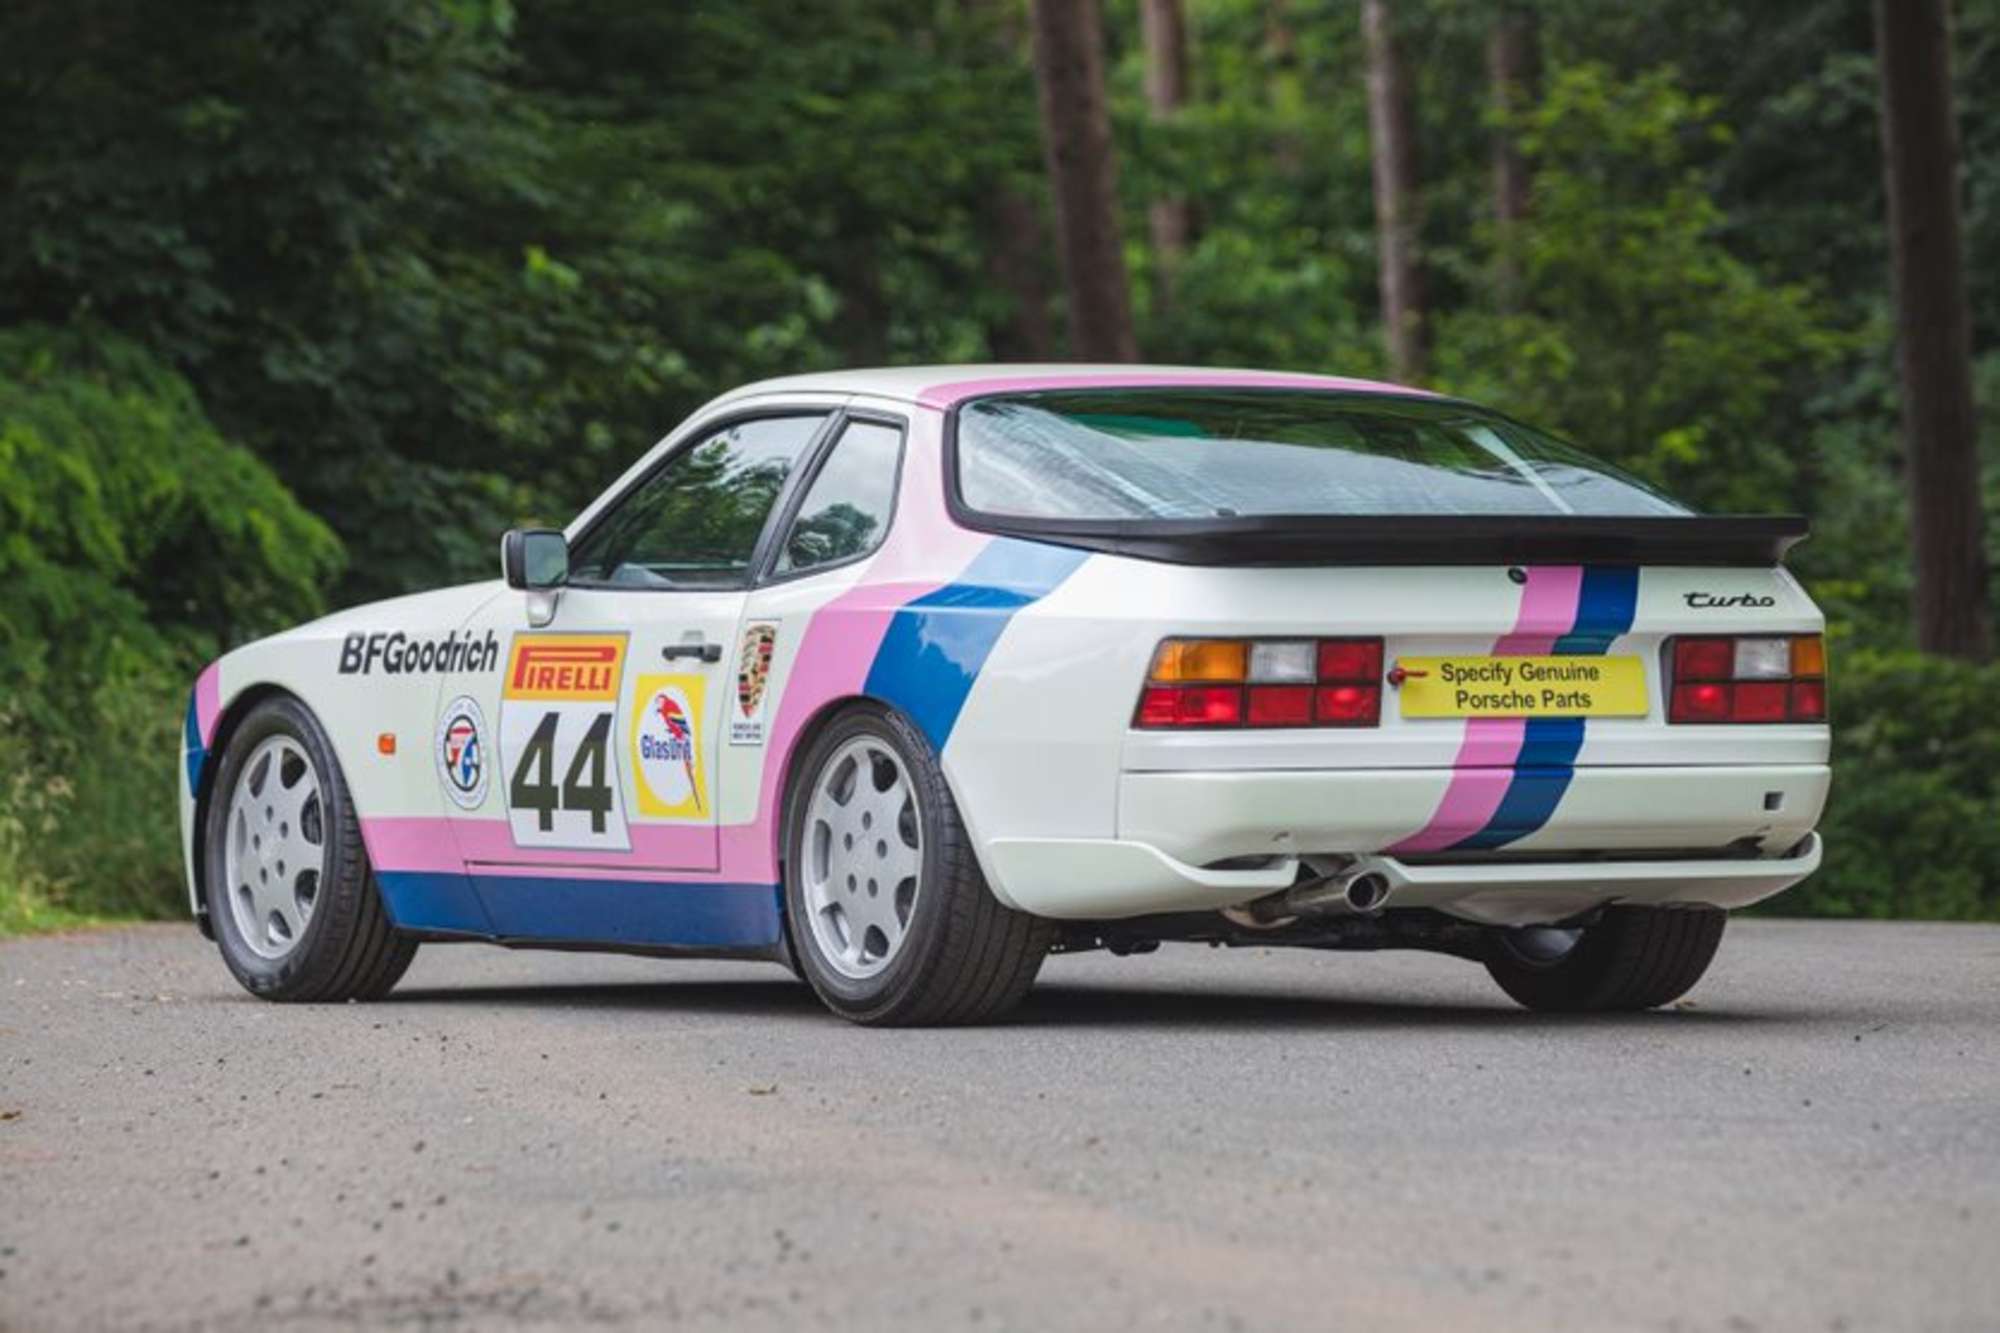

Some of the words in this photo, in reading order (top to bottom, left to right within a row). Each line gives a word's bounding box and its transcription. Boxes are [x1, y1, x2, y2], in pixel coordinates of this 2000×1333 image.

[338, 629, 499, 674] BFGoodrich
[514, 646, 617, 691] PIRELLI
[1441, 662, 1513, 686] Specify
[1519, 661, 1600, 681] Genuine
[1456, 689, 1536, 709] Porsche
[1541, 689, 1592, 708] Parts
[510, 712, 613, 833] 44
